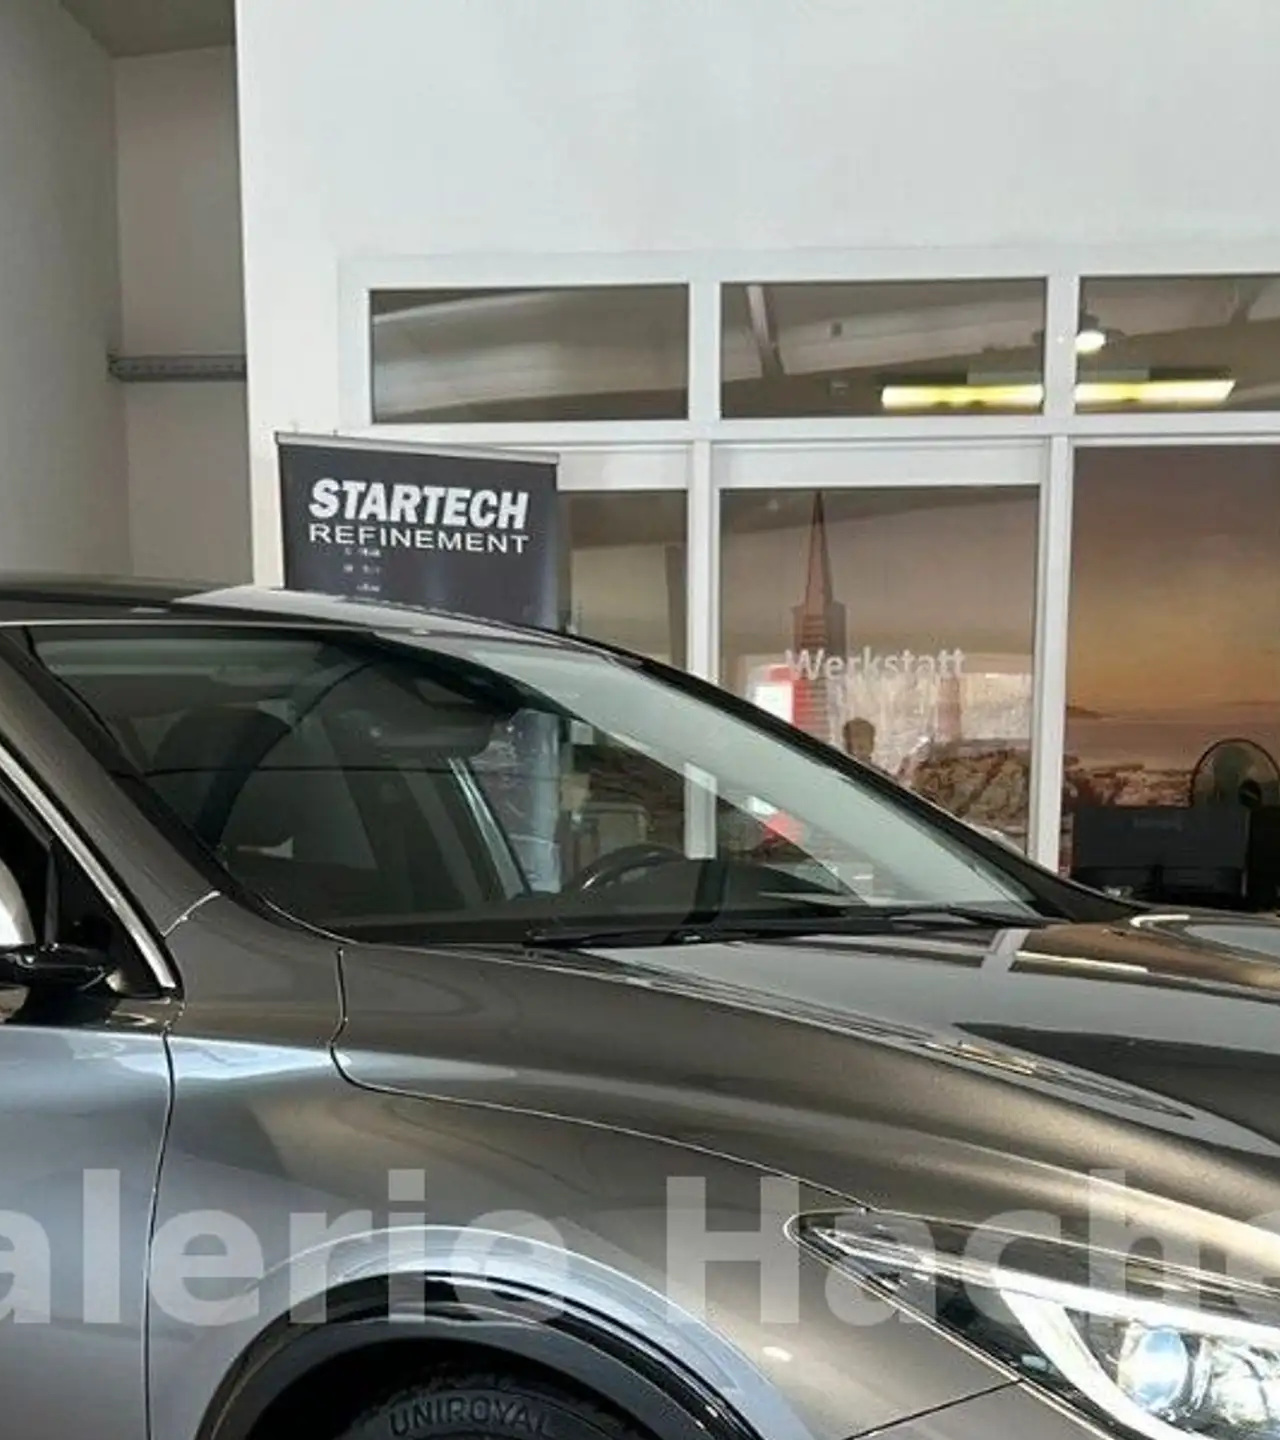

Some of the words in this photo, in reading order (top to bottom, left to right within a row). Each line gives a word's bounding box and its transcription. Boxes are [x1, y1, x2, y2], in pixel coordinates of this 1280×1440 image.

[308, 477, 530, 530] STARTECH
[308, 522, 530, 554] REFINEMENT
[783, 645, 966, 682] Werkstatt
